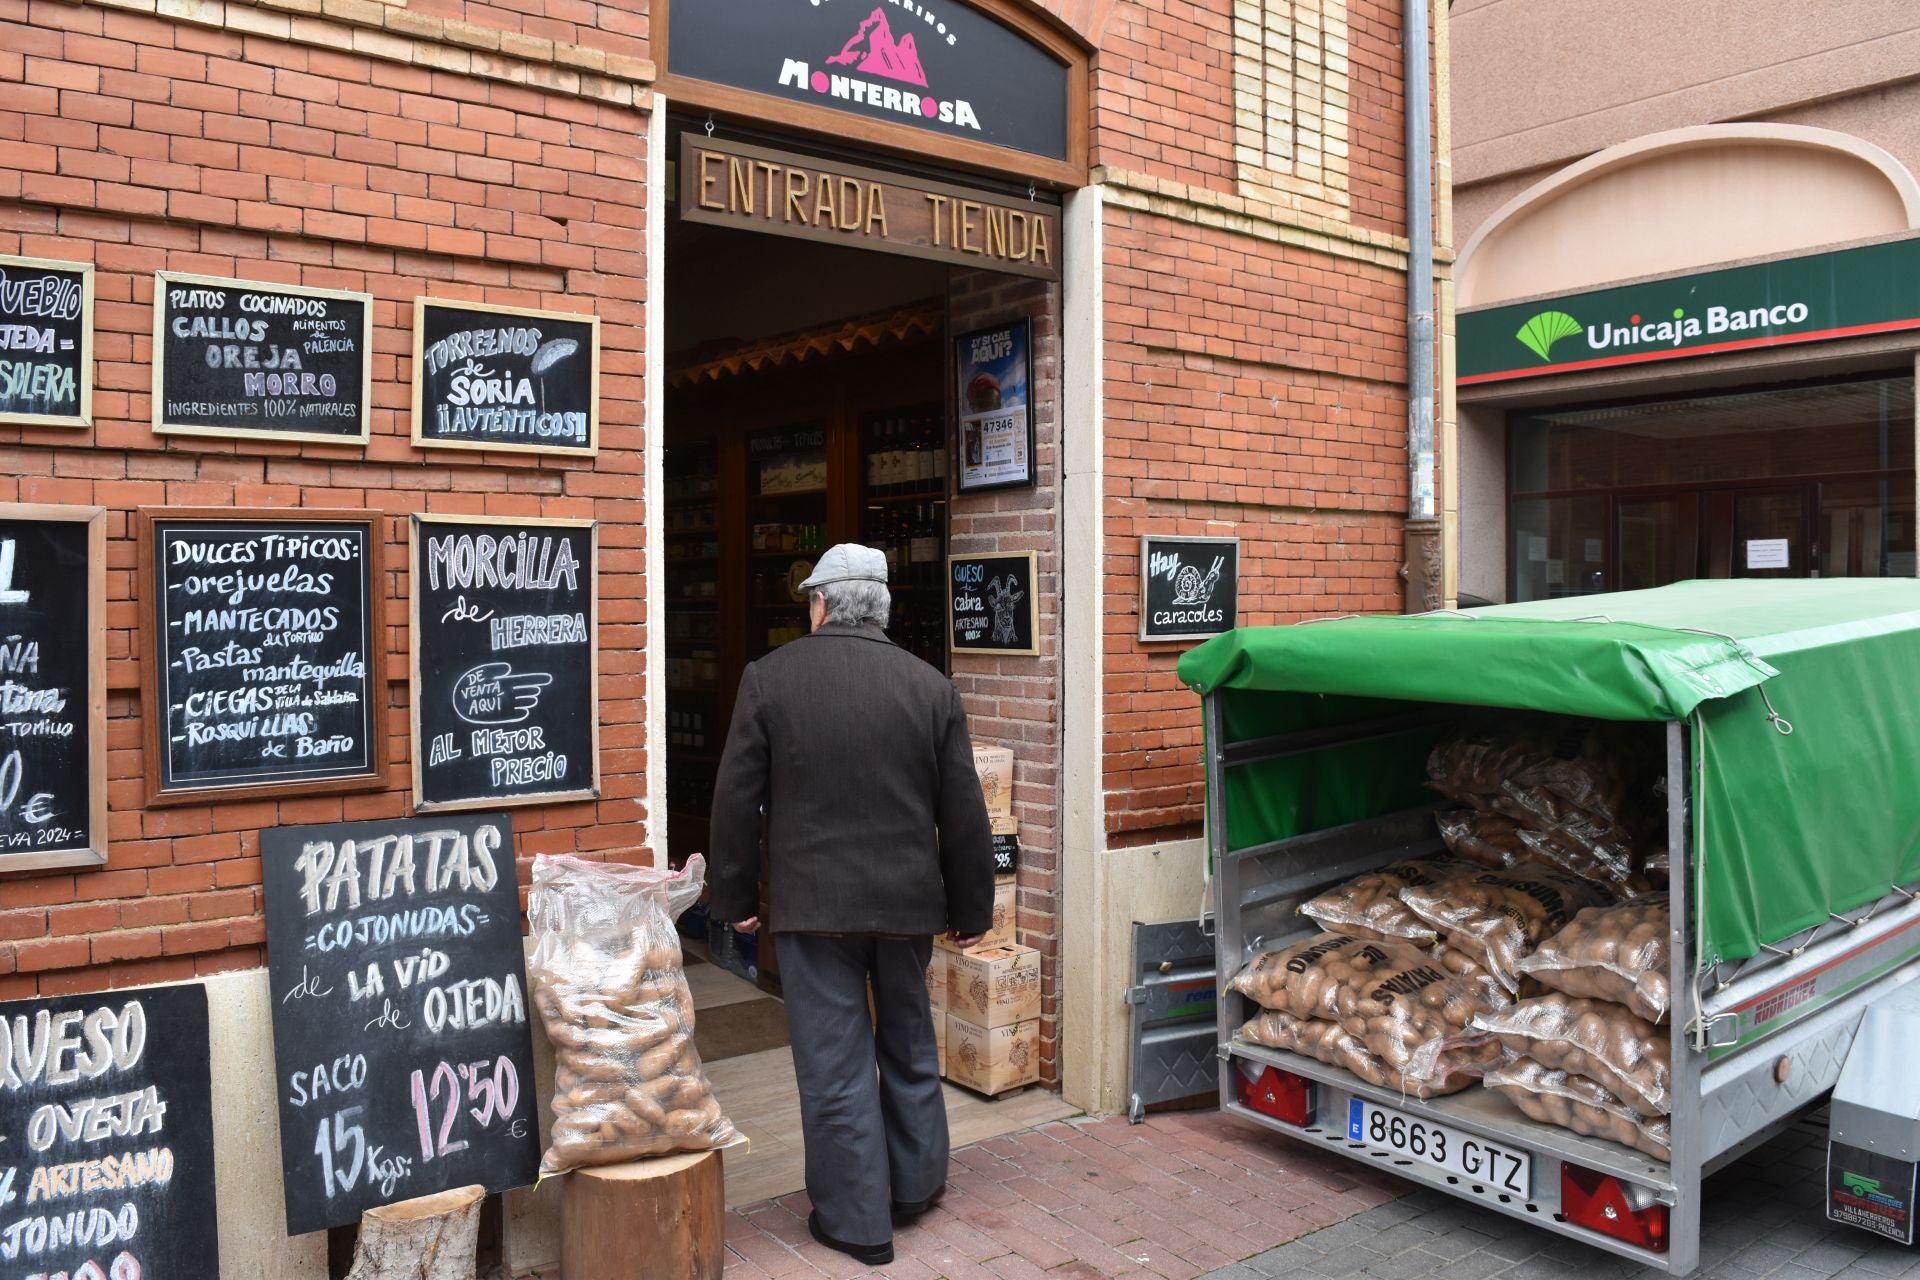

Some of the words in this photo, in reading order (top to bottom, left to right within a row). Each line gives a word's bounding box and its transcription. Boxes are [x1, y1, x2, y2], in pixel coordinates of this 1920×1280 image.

[699, 150, 888, 237] ENTRADA
[925, 194, 1050, 265] TIENDA
[0, 268, 82, 320] UEBLO
[169, 289, 226, 309] PLATOS
[172, 316, 269, 342] CALLOS
[309, 331, 330, 339] de
[1588, 308, 1702, 349] Unicaja
[1707, 302, 1808, 334] Banco
[424, 327, 543, 376] TORREZNOS
[450, 358, 496, 377] de
[243, 372, 336, 397] MORRO
[263, 399, 297, 417] 100%
[299, 403, 357, 418] NATURALES
[983, 418, 1013, 433] 47346
[169, 540, 259, 565] DULCES
[1150, 551, 1181, 581] Hay
[954, 564, 984, 582] QUESO
[441, 595, 494, 624] de
[954, 617, 989, 631] ARTESANO
[1153, 604, 1223, 625] caracoles
[490, 612, 587, 650] HERRERA
[965, 631, 981, 640] 100%
[243, 652, 367, 689] mantequilla
[467, 670, 485, 685] DE
[0, 682, 66, 713] tina
[274, 685, 289, 695] DE
[301, 695, 313, 706] de
[461, 681, 501, 699] VENTA
[261, 740, 287, 758] de
[295, 734, 354, 758] Baño
[430, 733, 461, 766] AL
[472, 726, 546, 757] MEJOR
[974, 755, 989, 764] INO
[19, 793, 55, 823] €
[294, 824, 502, 917] PATATAS
[282, 964, 334, 1005] de
[347, 961, 384, 1002] LA
[1371, 966, 1445, 1006] PATATAS
[363, 998, 411, 1032] de
[424, 973, 526, 1034] OJEDA
[290, 1053, 367, 1107] SACO
[28, 1085, 167, 1151] OVEJA
[314, 1104, 364, 1199] 15
[1352, 1123, 1359, 1133] E
[1370, 1110, 1446, 1163] 8663
[1462, 1141, 1522, 1193] GTZ
[26, 1147, 174, 1205] ARTESANO
[0, 1202, 139, 1259] JONUDO
